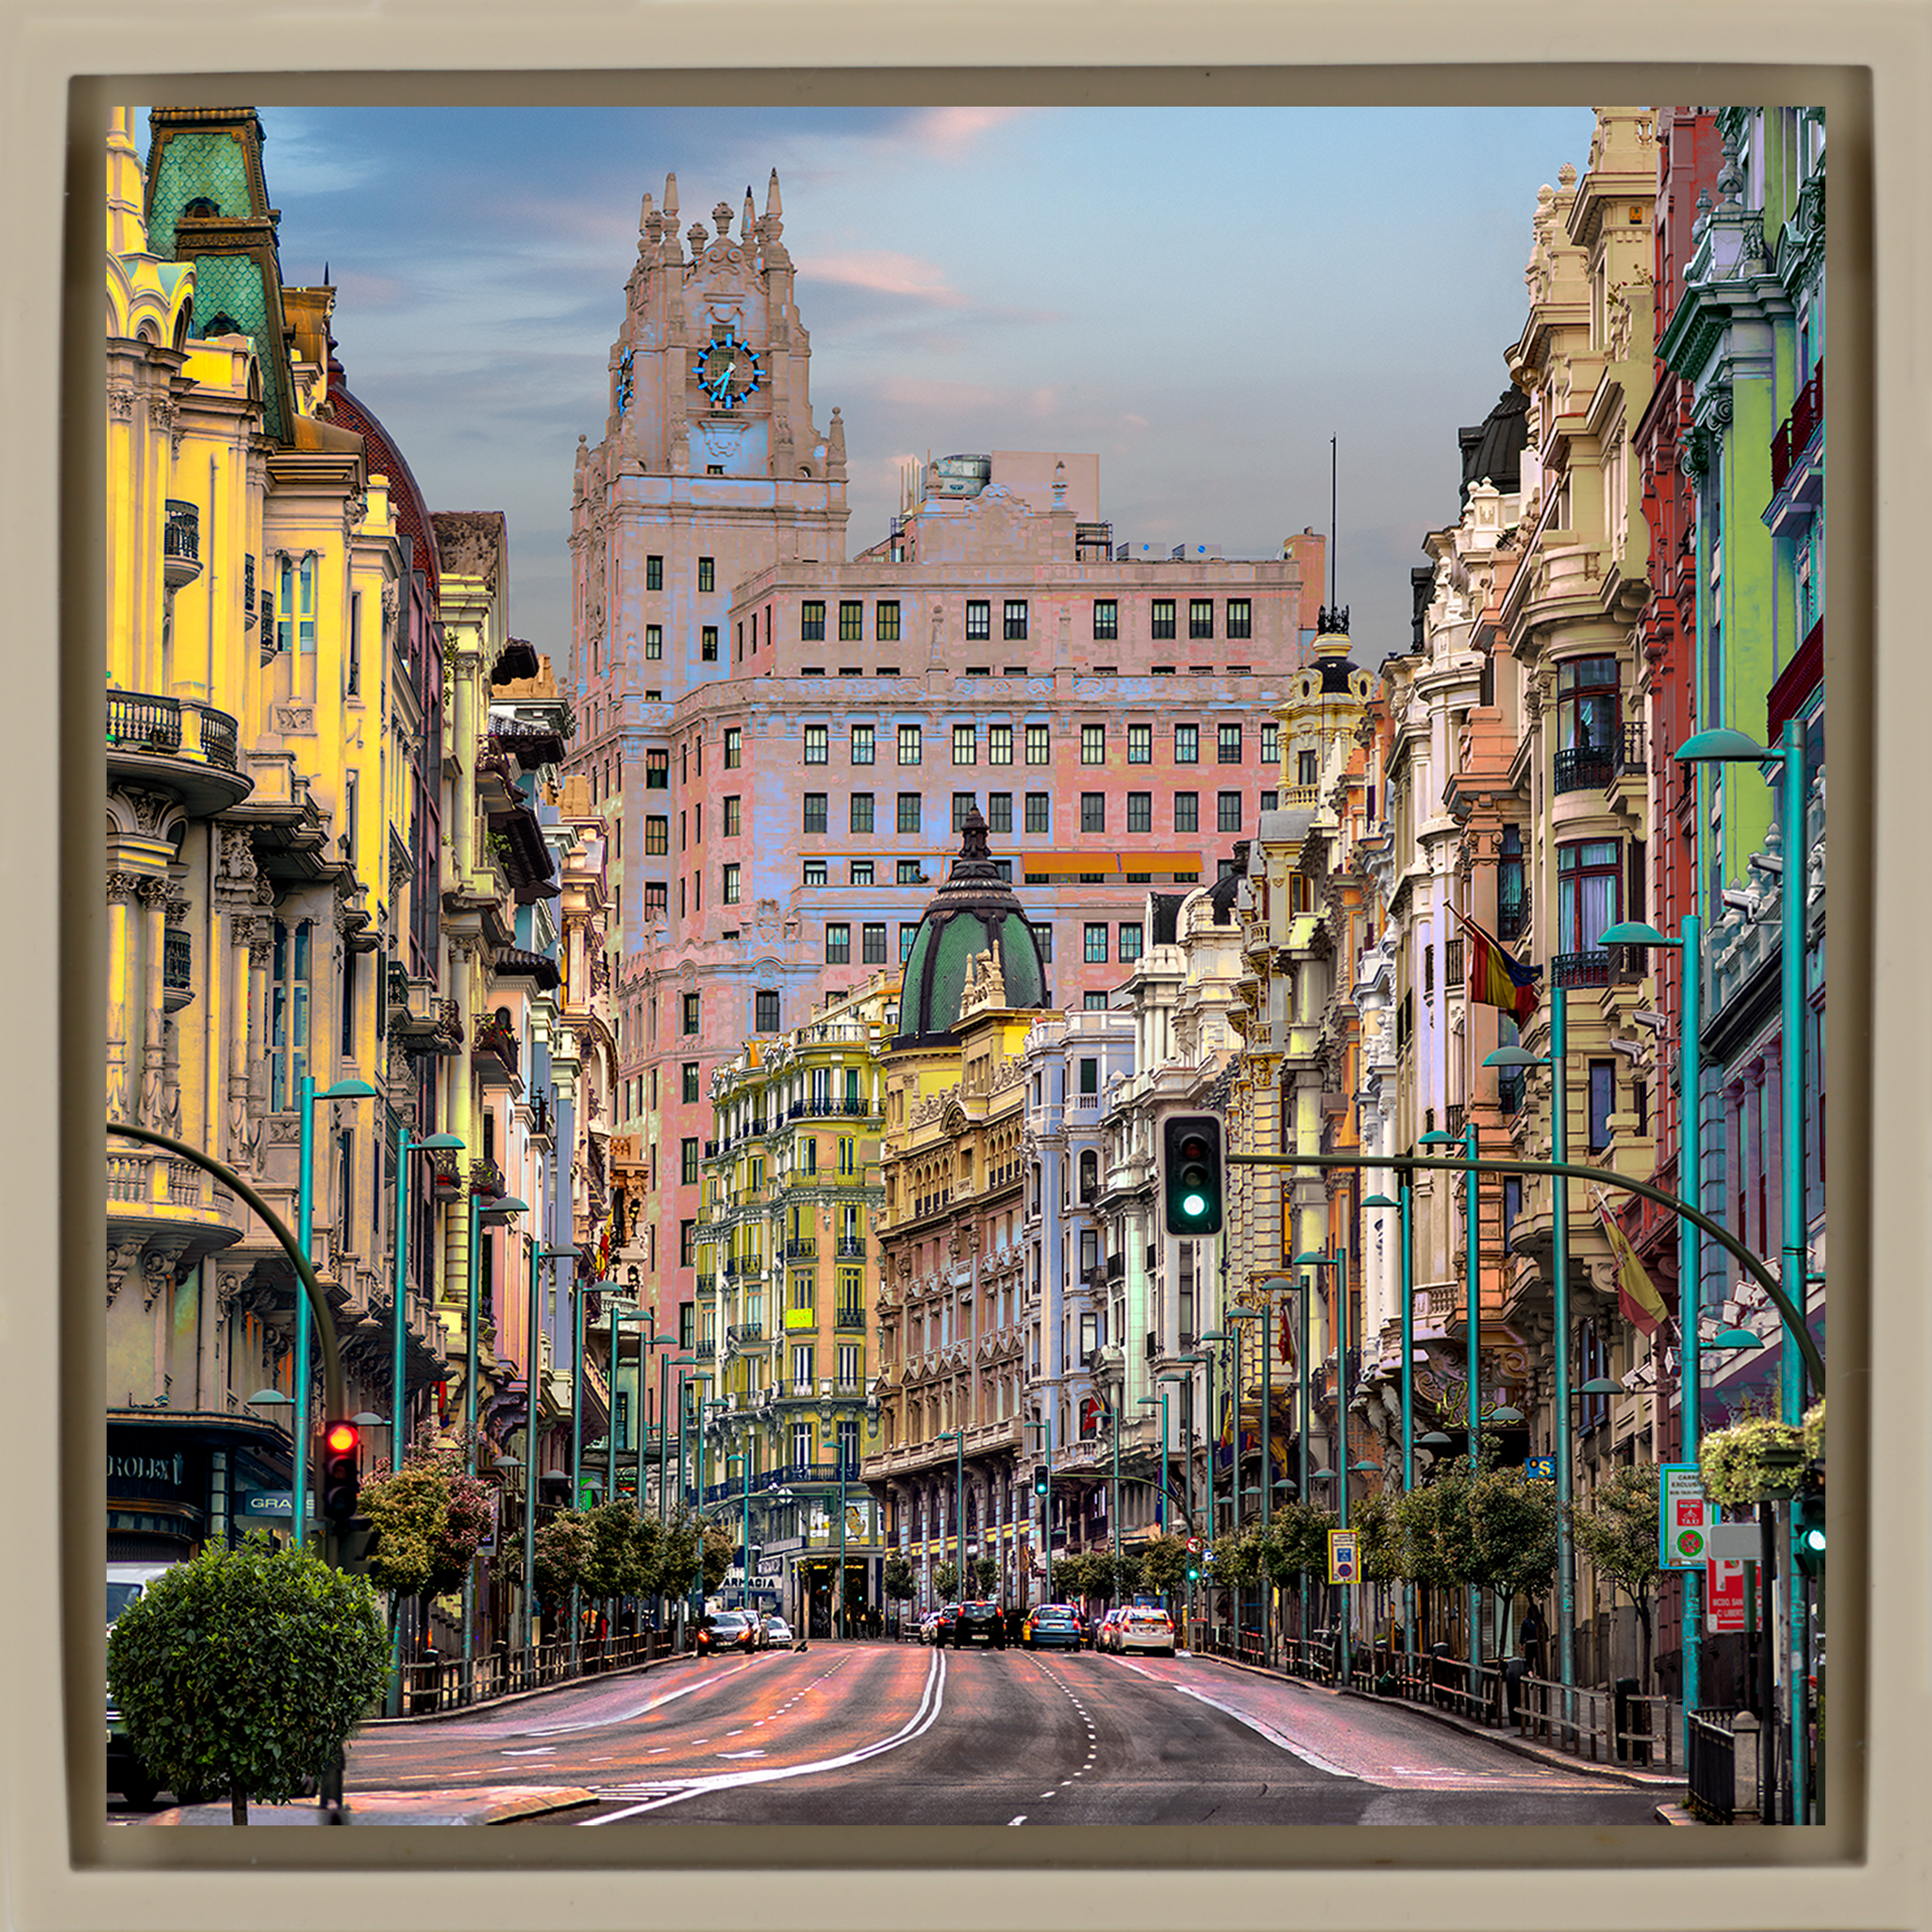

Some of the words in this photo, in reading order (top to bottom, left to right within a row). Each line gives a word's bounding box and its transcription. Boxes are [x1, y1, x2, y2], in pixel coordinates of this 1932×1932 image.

[107, 1455, 171, 1480] ROLEX
[251, 1498, 315, 1509] GRAS
[723, 1577, 775, 1588] ARMACIA
[1724, 1608, 1743, 1617] LIBERT
